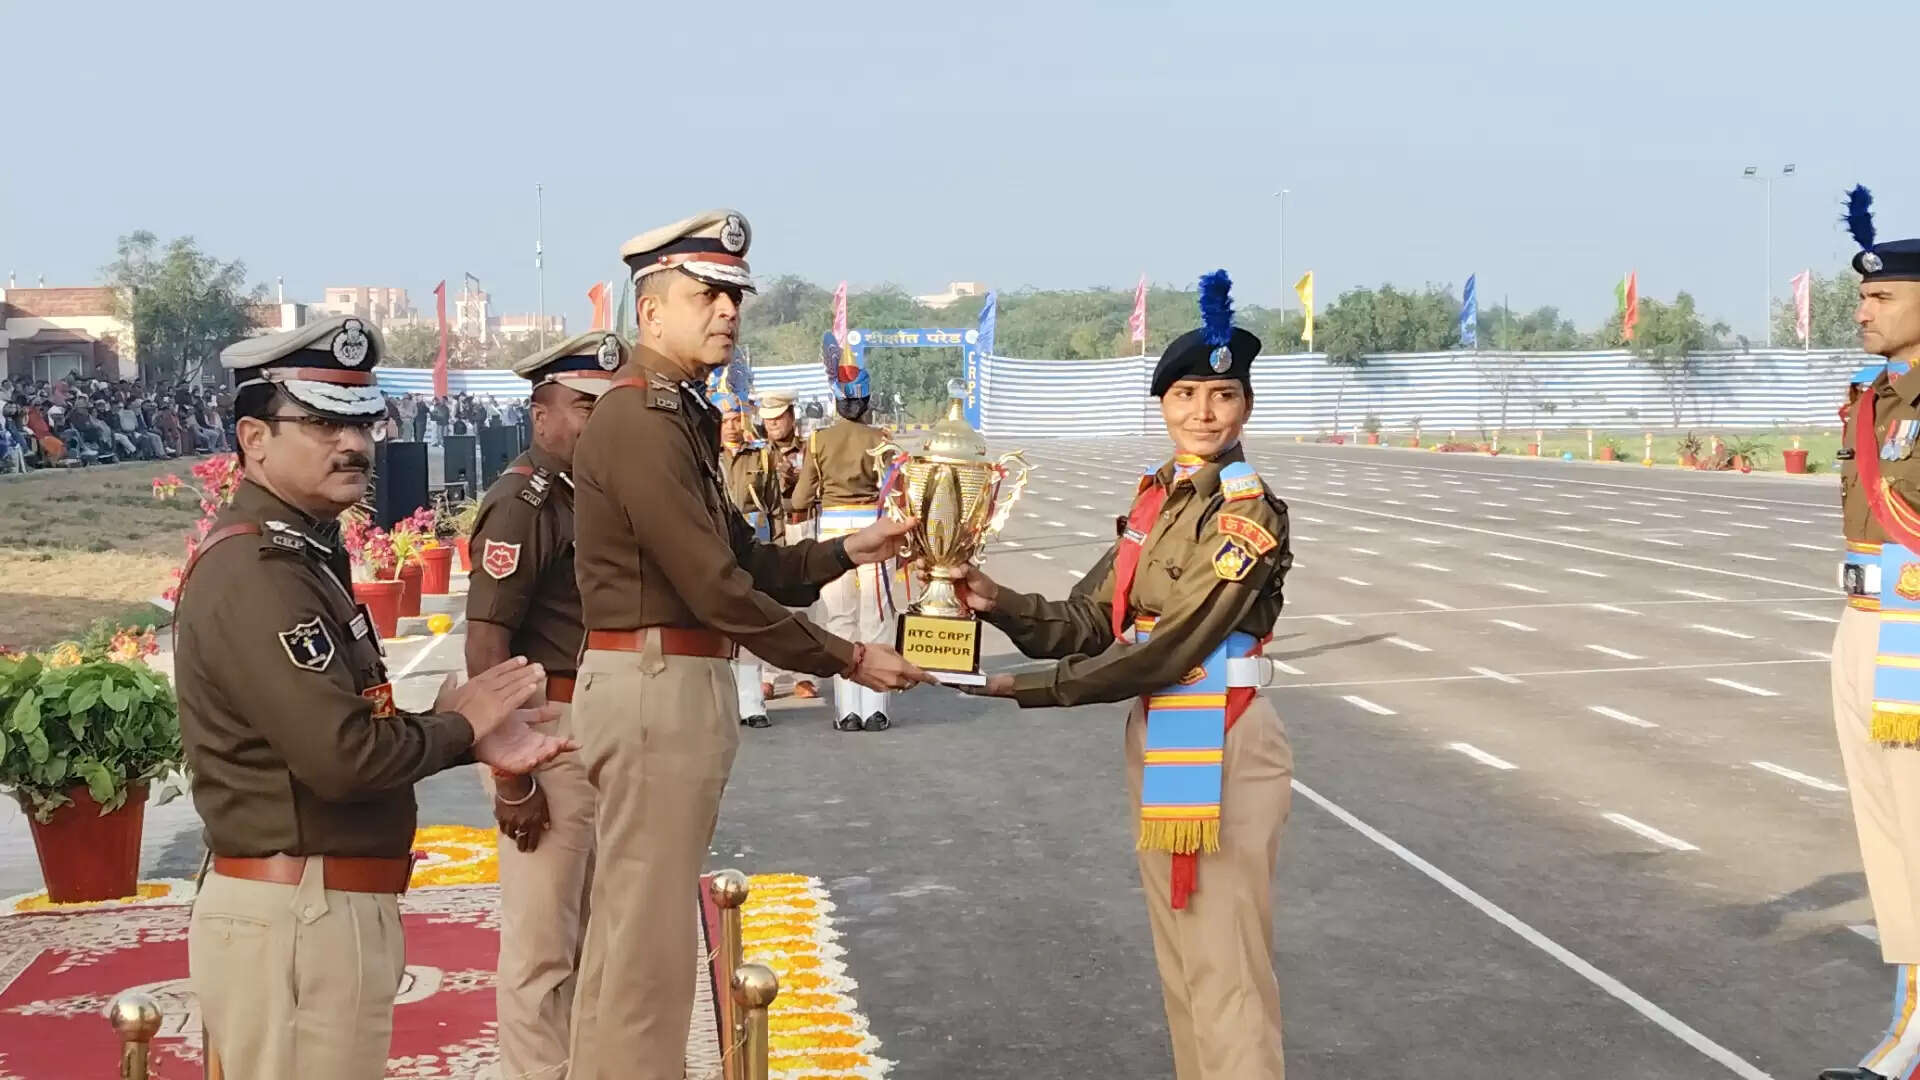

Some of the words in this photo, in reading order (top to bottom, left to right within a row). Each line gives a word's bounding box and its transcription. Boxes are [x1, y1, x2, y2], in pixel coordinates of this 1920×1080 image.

[926, 329, 961, 344] परेड
[967, 351, 976, 409] CRPF
[908, 629, 933, 638] RTC
[938, 631, 973, 641] CRPF
[907, 643, 971, 656] JODHPUR
